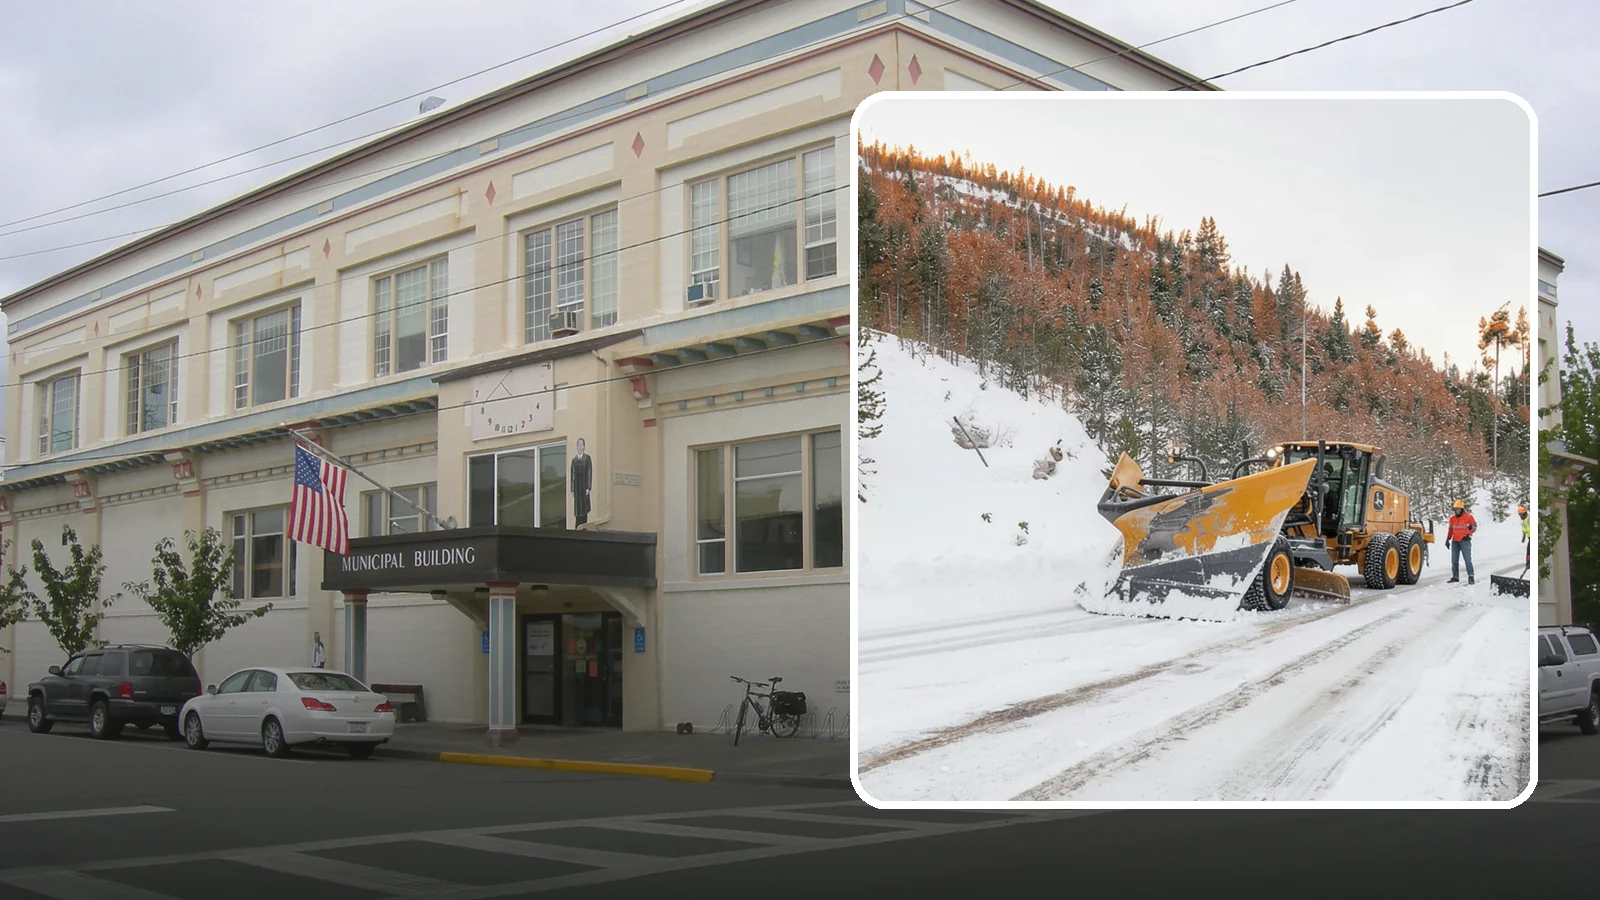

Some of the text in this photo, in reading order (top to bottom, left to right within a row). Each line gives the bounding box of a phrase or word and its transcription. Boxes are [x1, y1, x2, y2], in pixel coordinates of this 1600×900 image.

[475, 390, 479, 398] 7
[536, 402, 540, 410] 4
[481, 407, 485, 415] 8
[488, 417, 492, 425] 9
[529, 413, 533, 422] 3
[495, 424, 500, 432] 10
[521, 420, 526, 428] 2
[342, 546, 475, 571] MUNICIPAL BUILDING
